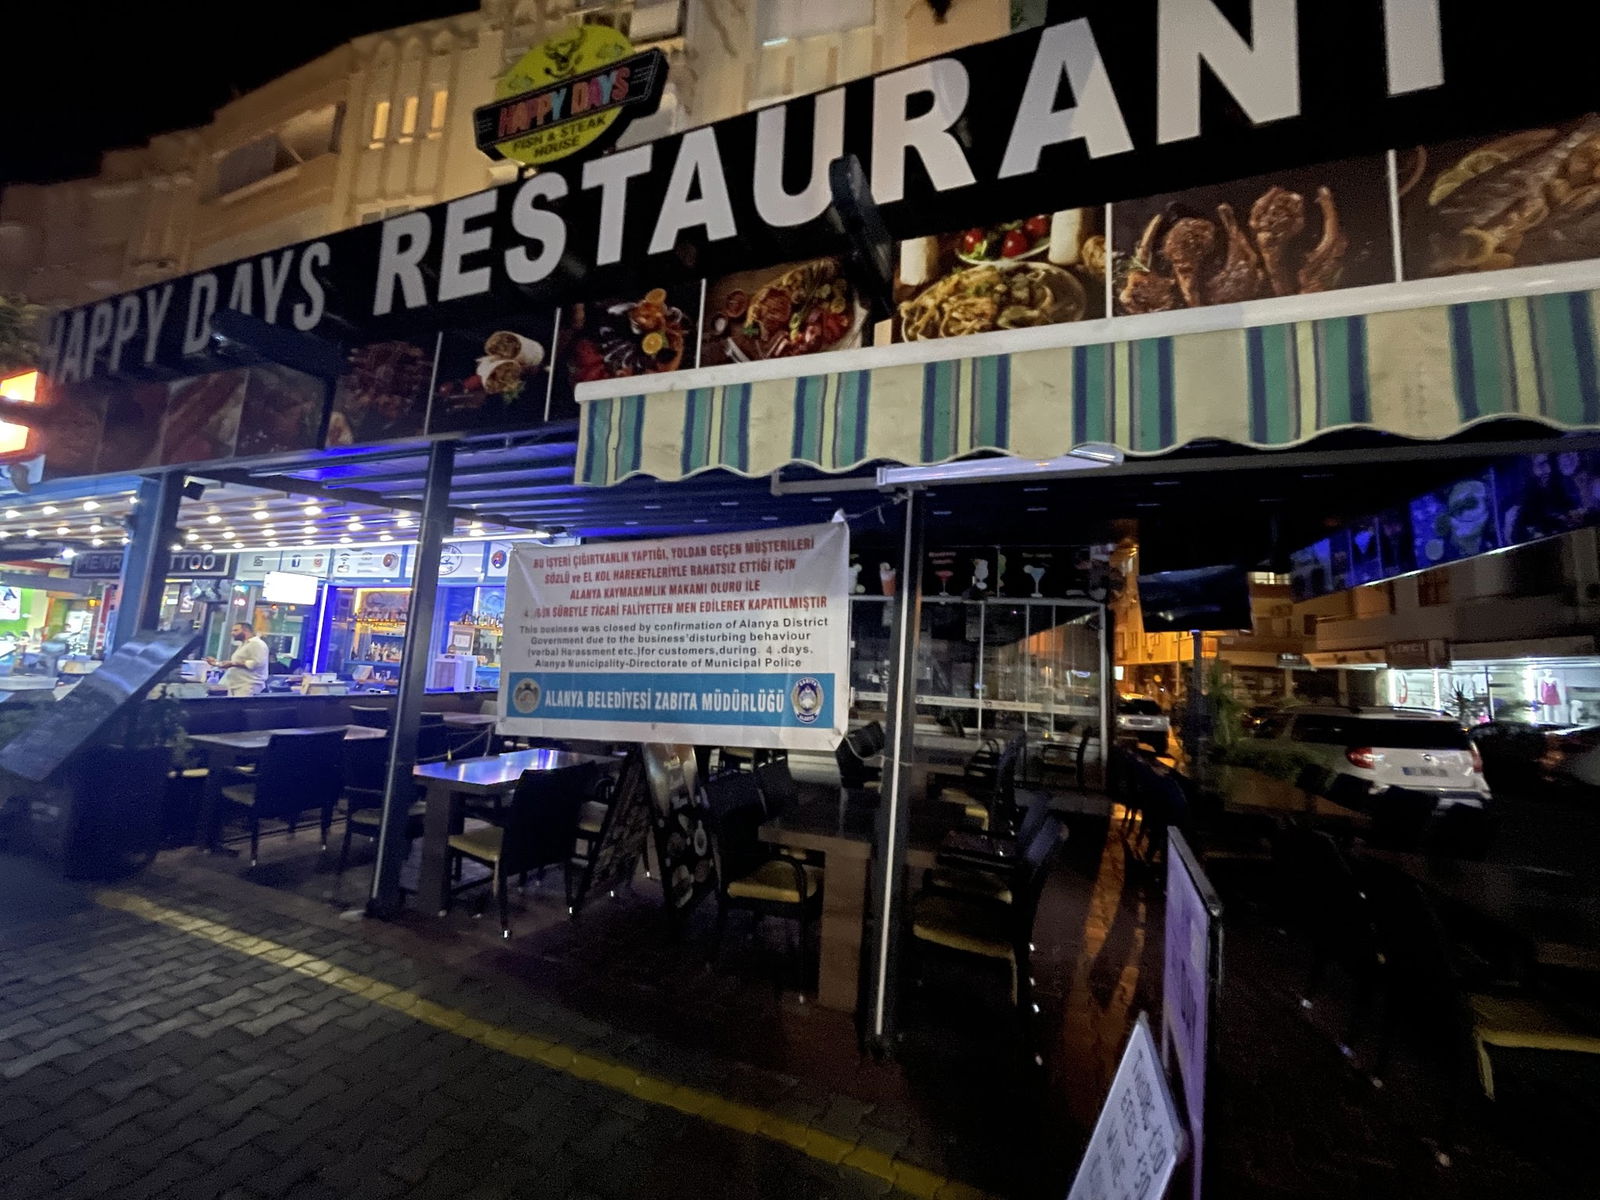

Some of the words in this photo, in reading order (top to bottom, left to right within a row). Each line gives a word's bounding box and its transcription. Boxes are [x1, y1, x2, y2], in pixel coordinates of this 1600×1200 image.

[499, 87, 567, 138] HAPPY
[571, 67, 630, 115] DAYS
[513, 134, 543, 152] FISH
[547, 131, 556, 141] &
[560, 116, 607, 137] STEAK
[535, 136, 580, 157] HOUSE
[47, 283, 174, 384] HAPPY
[182, 242, 331, 357] DAYS
[672, 546, 707, 559] YOLDAN
[710, 543, 742, 558] GEÇEN
[745, 536, 815, 556] MÜŞTERİLERİ
[544, 570, 570, 584] SÖZLÜ
[572, 574, 581, 583] ve
[583, 573, 593, 582] EL
[595, 571, 610, 581] KOL
[613, 566, 688, 580] HAREKETLERİYLE
[691, 563, 736, 576] RAHATSIZ
[739, 558, 771, 573] ETTİĞİ
[774, 556, 796, 574] İÇİN
[570, 588, 601, 600] ALANYA
[603, 585, 666, 599] KAYMAKAMLIK
[669, 583, 707, 595] MAKAMI
[710, 580, 742, 593] OLURU
[745, 580, 761, 591] İLE
[552, 605, 589, 617] SÜREYLE
[591, 602, 619, 617] TİCARİ
[622, 601, 673, 615] FALİYETTEN
[676, 601, 697, 613] MEN
[700, 598, 745, 613] EDİLEREK
[749, 596, 827, 612] KAPATILMIŞTIR
[520, 625, 538, 634] This
[540, 624, 579, 634] business
[582, 625, 600, 633] was
[603, 623, 636, 632] closed
[639, 622, 651, 634] by
[654, 620, 723, 631] confirmation
[725, 620, 736, 630] of
[739, 618, 779, 631] Alanya
[783, 617, 828, 627] District
[530, 636, 584, 645] Government
[586, 635, 604, 644] due
[607, 636, 617, 644] to
[619, 635, 635, 643] the
[750, 632, 811, 642] behaviour
[561, 647, 616, 656] Harassment
[766, 645, 772, 655] 4
[535, 660, 566, 669] Alanya
[568, 658, 688, 669] Municipality-Directorate
[691, 658, 701, 667] of
[705, 658, 761, 669] Municipal
[765, 658, 801, 667] Police
[545, 690, 584, 708] ALANYA
[587, 688, 651, 709] BELEDİYESİ
[655, 691, 697, 711] ZABITA
[702, 689, 784, 713] MÜDÜRLÜĞÜ
